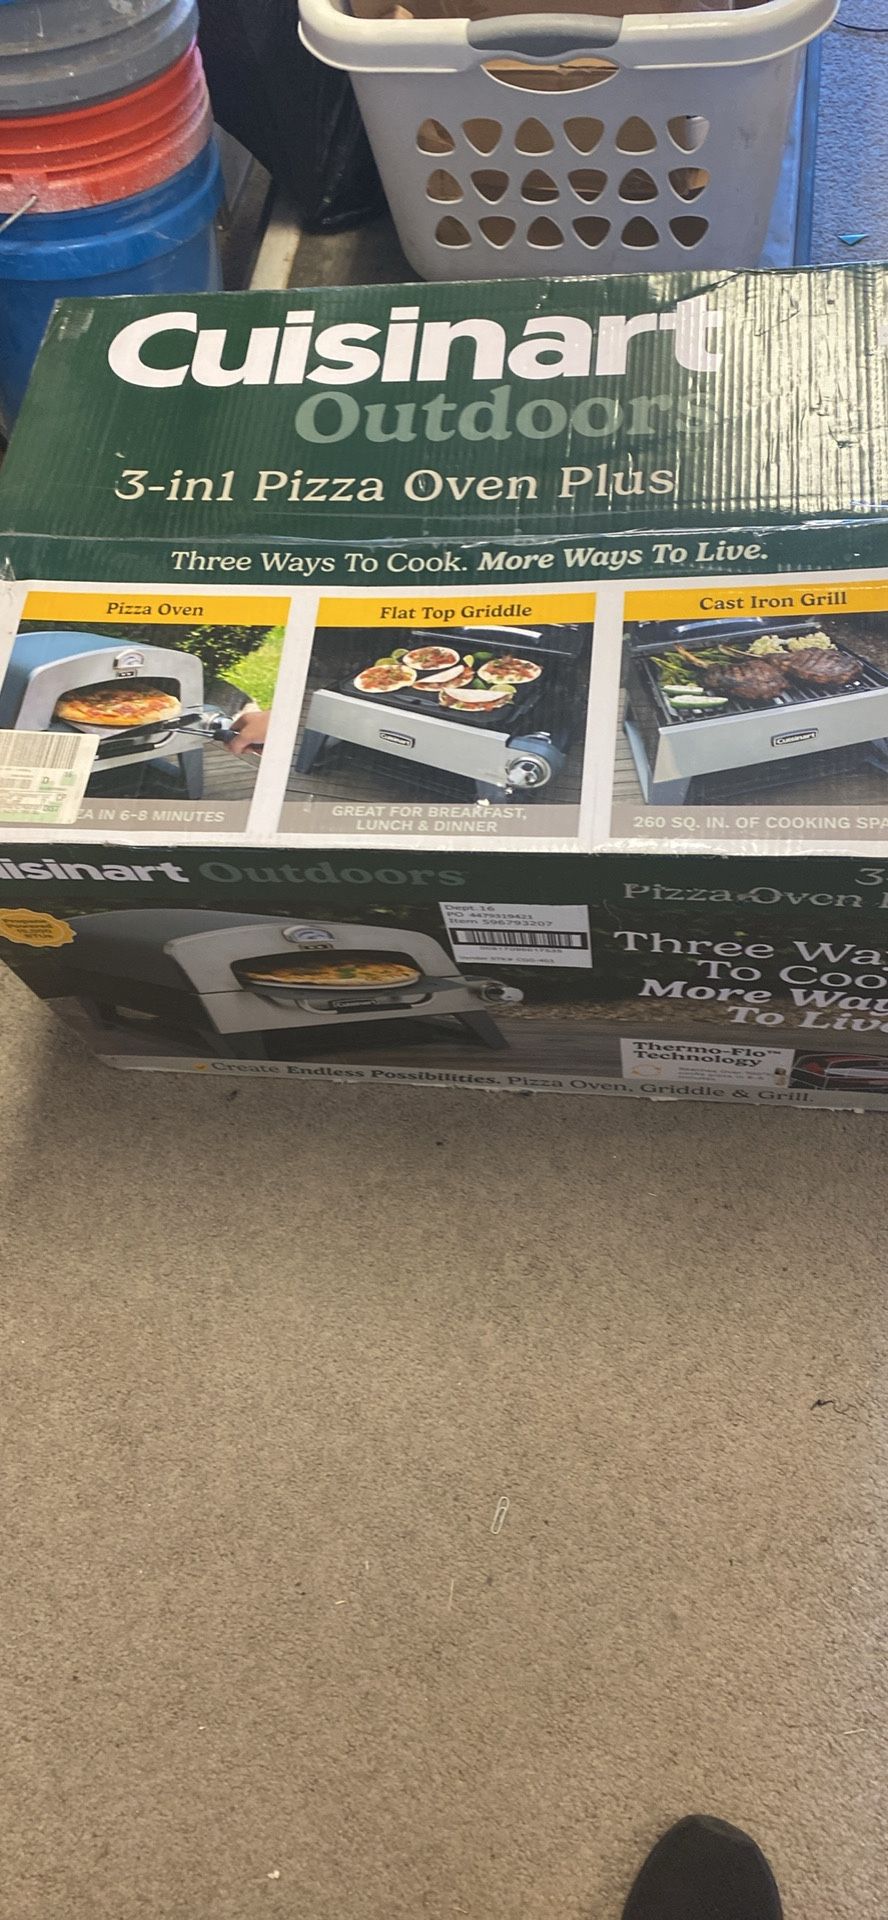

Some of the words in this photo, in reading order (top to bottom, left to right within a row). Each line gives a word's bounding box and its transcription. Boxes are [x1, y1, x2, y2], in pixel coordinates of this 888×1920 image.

[108, 295, 723, 388] Cuisinart
[294, 385, 719, 444] Outdoors
[115, 469, 235, 501] 3-in1
[254, 469, 385, 502] Pizza
[404, 470, 537, 502] Oven
[557, 464, 674, 498] Plus
[171, 551, 252, 572] Three
[262, 552, 335, 577] Ways
[344, 553, 378, 572] To
[387, 551, 467, 573] Cook.
[477, 550, 554, 571] More
[563, 546, 642, 566] Ways
[652, 542, 686, 564] To
[695, 541, 768, 563] Live.
[106, 602, 151, 615] Pizza
[158, 603, 204, 616] Oven
[700, 597, 744, 610] Cast
[751, 595, 794, 609] Iron
[801, 591, 847, 606] Grill
[380, 606, 415, 619] Flat
[422, 607, 455, 621] Top
[461, 604, 532, 618] Griddle
[100, 808, 116, 820] IN
[120, 808, 148, 821] 6-8
[152, 809, 225, 822] MINUTES
[332, 805, 384, 817] GREAT
[389, 805, 422, 817] FOR
[428, 806, 527, 820] BREAKFAST,
[633, 816, 666, 829] 260
[671, 816, 699, 830] SQ.
[706, 816, 730, 829] IN.
[735, 816, 760, 829] OF
[765, 816, 850, 829] COOKING
[356, 820, 413, 832] LUNCH
[417, 821, 428, 832] &
[433, 820, 497, 833] DINNER
[199, 862, 466, 887] Outdoors
[623, 883, 733, 902] Pizza
[748, 887, 863, 908] Oven
[613, 931, 775, 959] Three
[697, 960, 762, 982] To
[639, 978, 772, 1004] More
[727, 1006, 785, 1026] To
[633, 1050, 763, 1068] Technology
[211, 1061, 279, 1074] Create
[287, 1065, 365, 1078] Endless
[371, 1069, 500, 1085] Possibilities.
[507, 1075, 563, 1088] Pizza
[570, 1078, 633, 1094] Oven.
[640, 1083, 725, 1098] Griddle
[732, 1088, 750, 1099] &
[758, 1089, 814, 1102] Grill.
